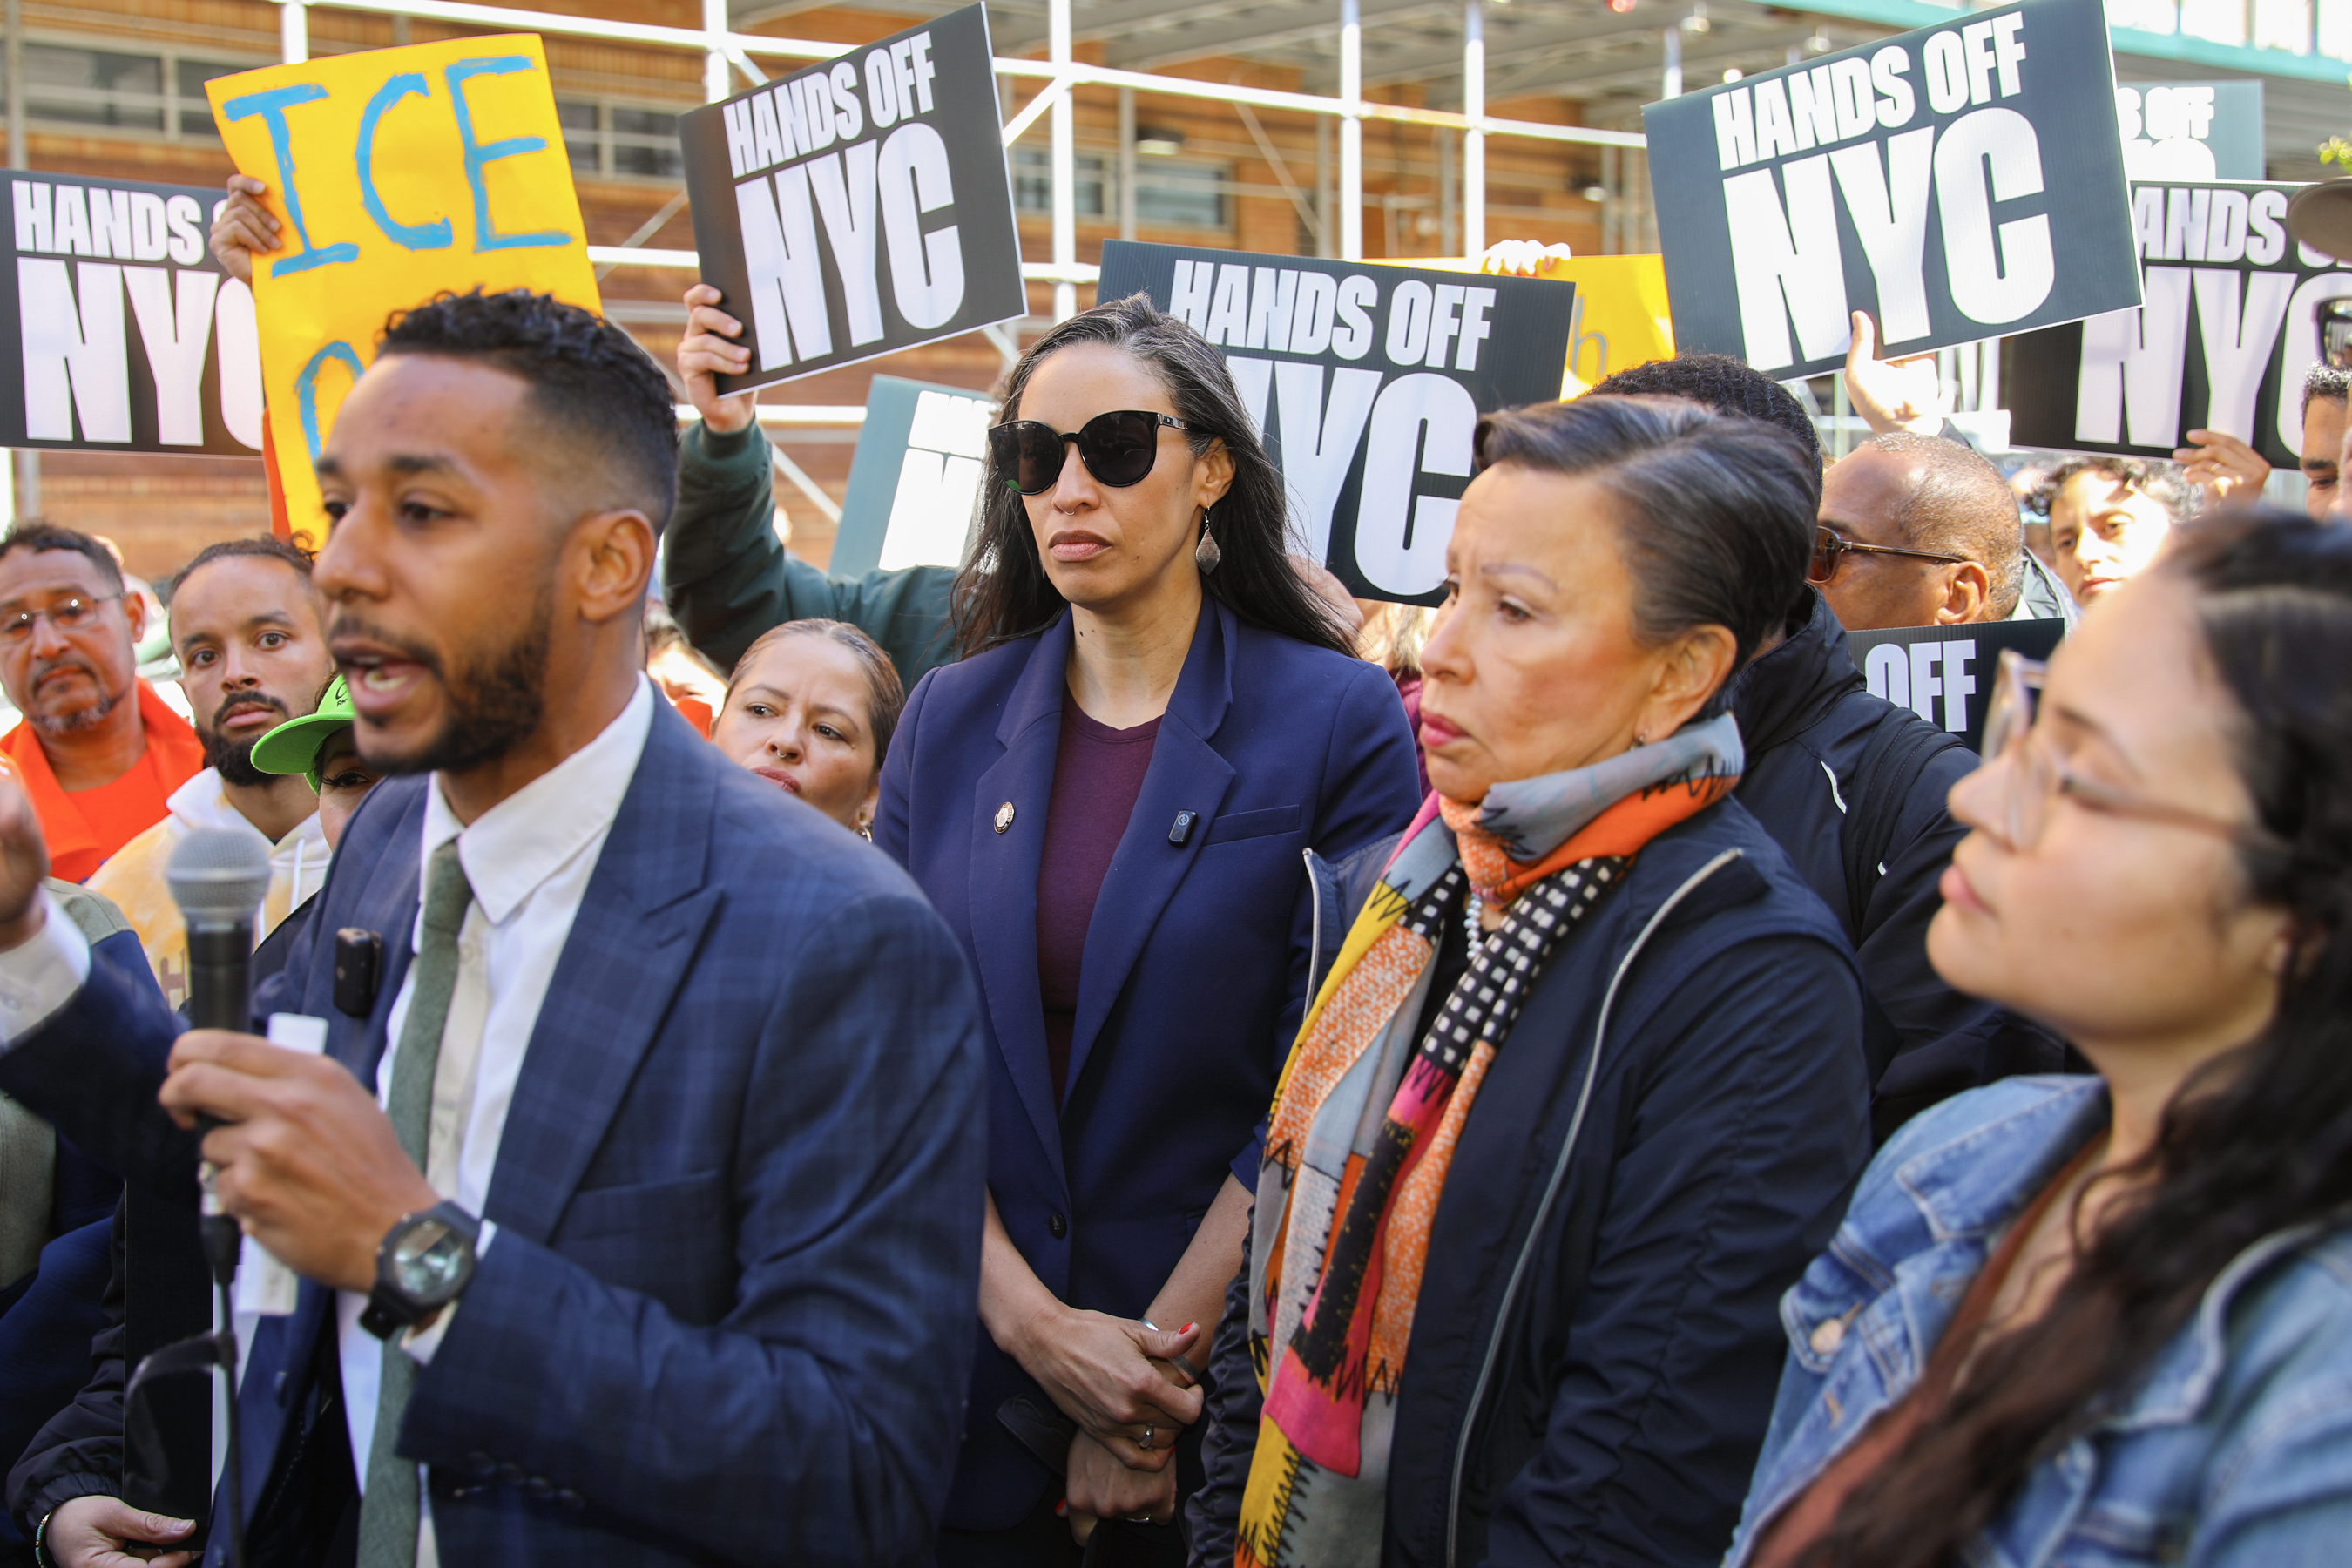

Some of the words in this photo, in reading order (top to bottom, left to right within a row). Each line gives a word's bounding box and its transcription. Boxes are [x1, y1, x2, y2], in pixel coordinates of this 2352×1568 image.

[223, 55, 575, 279] ICE
[722, 61, 863, 179] HANDS
[864, 30, 936, 128] OFF
[1711, 45, 1916, 172] HANDS
[1922, 11, 2027, 114] OFF
[12, 179, 205, 266] HANDS
[734, 122, 965, 372] NYC
[1722, 107, 2055, 371] NYC
[2133, 186, 2288, 267] ANDS
[1169, 260, 1378, 360] HANDS
[1385, 280, 1497, 371] OFF
[1225, 355, 1477, 596] YC
[1865, 639, 1976, 732] OFF
